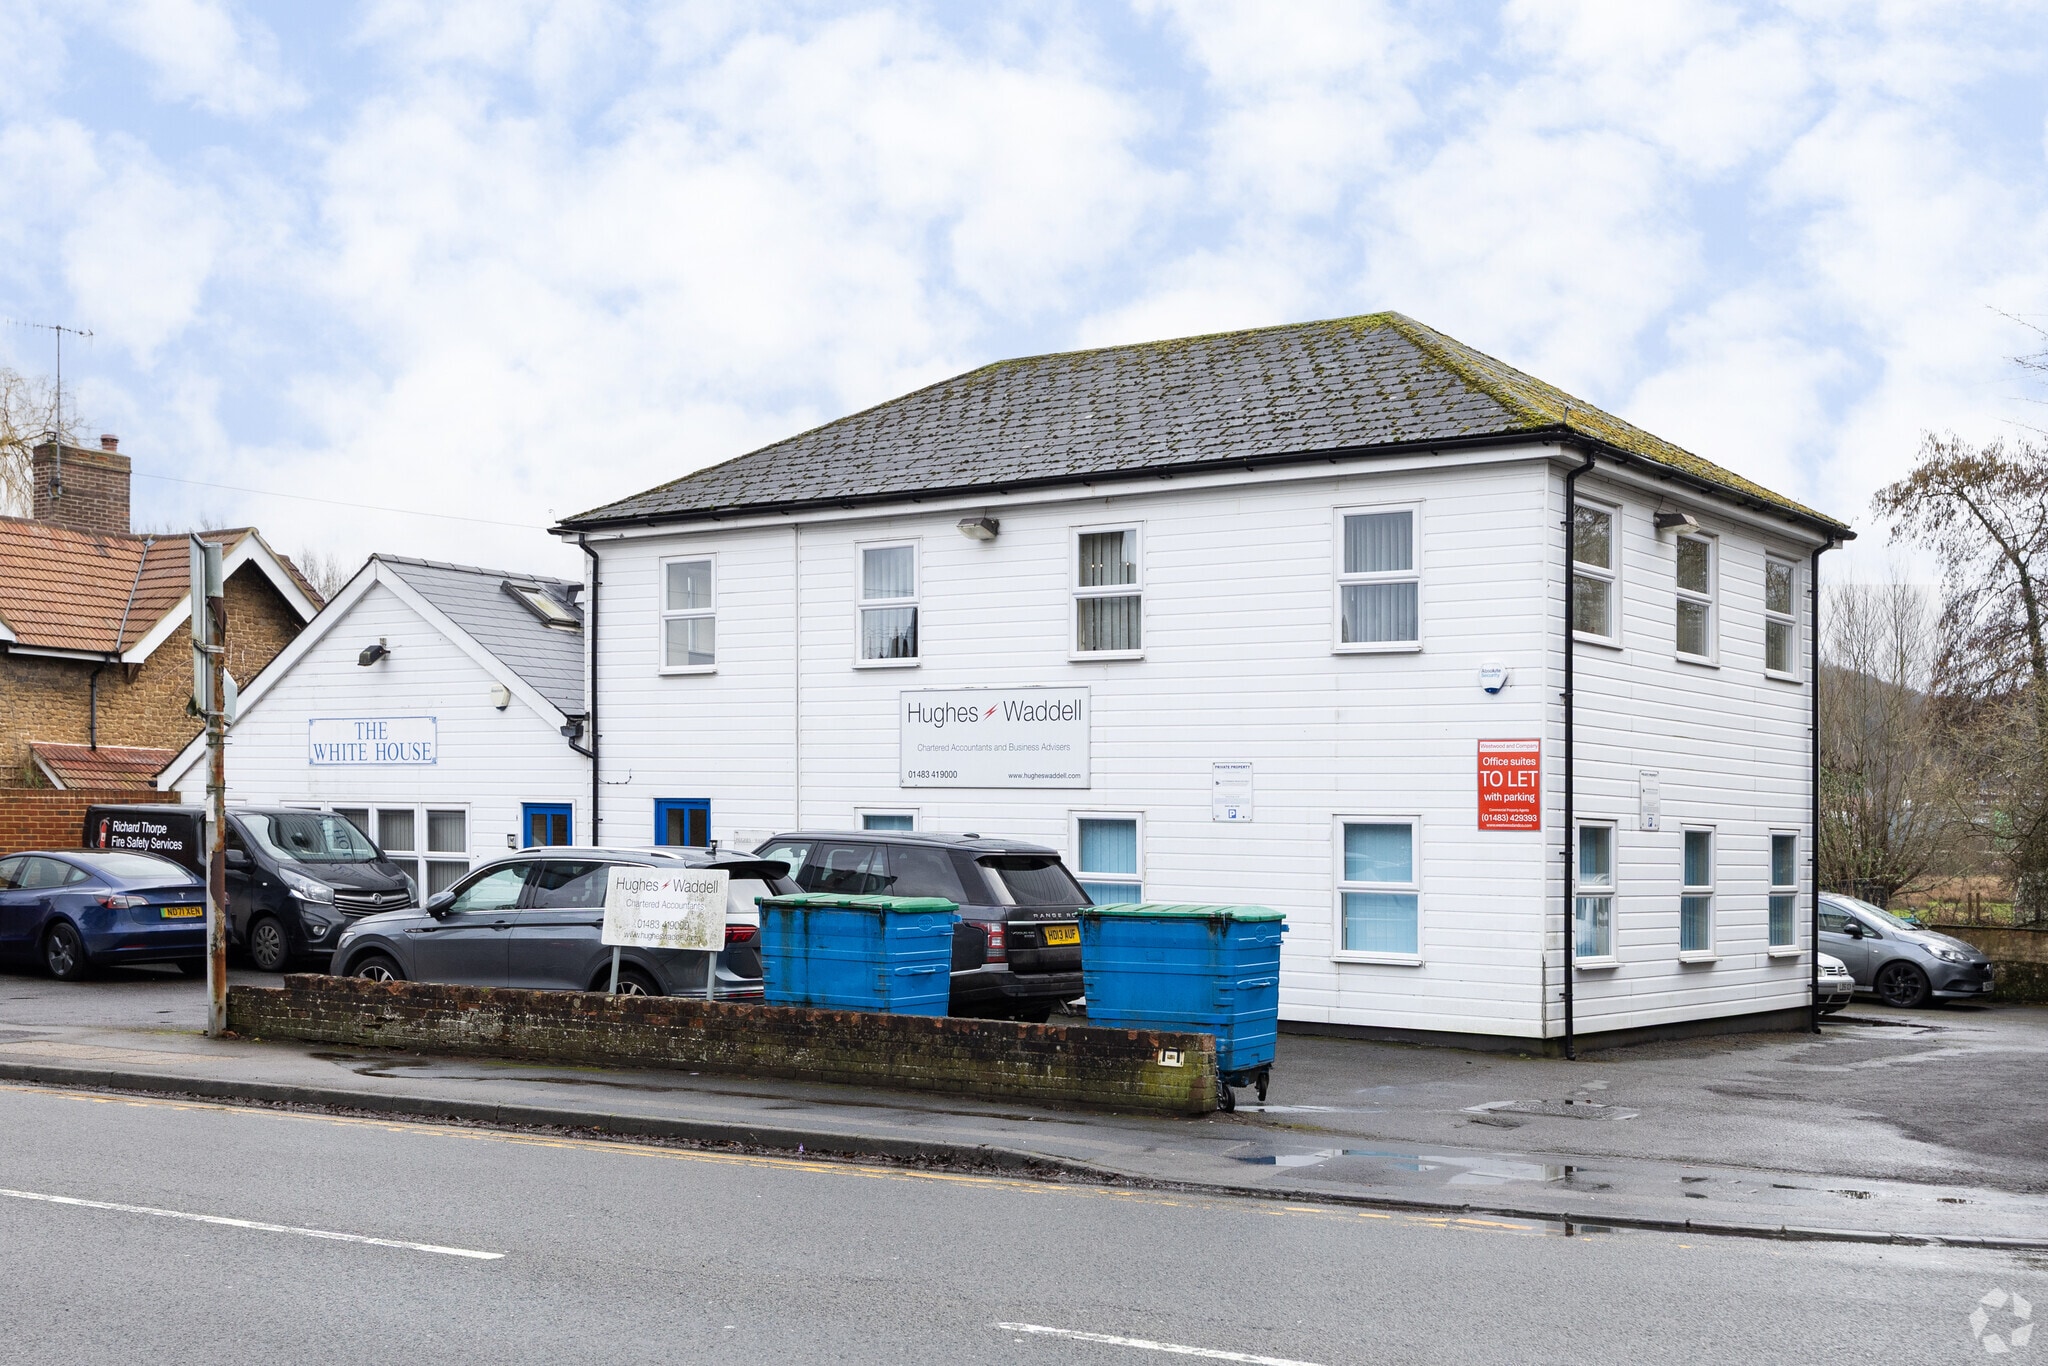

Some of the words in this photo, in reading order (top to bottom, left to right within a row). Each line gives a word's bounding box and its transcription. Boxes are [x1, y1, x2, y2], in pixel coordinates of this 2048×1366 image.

[908, 702, 979, 728] Hughes
[1003, 699, 1082, 722] Waddell
[354, 721, 388, 740] THE
[313, 743, 368, 761] WHITE
[376, 742, 432, 761] HOUSE
[917, 743, 949, 752] Chartered
[951, 743, 992, 751] Accountants
[994, 743, 1007, 751] and
[1008, 743, 1039, 751] Business
[1041, 742, 1070, 751] Advisers
[1483, 757, 1508, 766] Office
[1510, 758, 1536, 766] suites
[908, 770, 930, 779] 01483
[931, 770, 957, 779] 419000
[1480, 770, 1503, 787] TO
[1508, 770, 1538, 787] LET
[1484, 792, 1502, 801] with
[1504, 792, 1535, 803] parking
[1482, 814, 1508, 822] (01483)
[1510, 814, 1537, 822] 429393
[113, 820, 140, 832] Richard
[142, 822, 167, 836] Thorpe
[111, 836, 125, 847] Fire
[126, 836, 150, 851] Safety
[151, 837, 182, 850] Services
[616, 877, 659, 894] Hughes
[673, 879, 719, 894] Waddell
[626, 898, 660, 908] Chartered
[662, 900, 705, 911] Accountants
[637, 920, 660, 929] 01483
[1048, 930, 1063, 940] HD13
[1065, 929, 1076, 939] AUF
